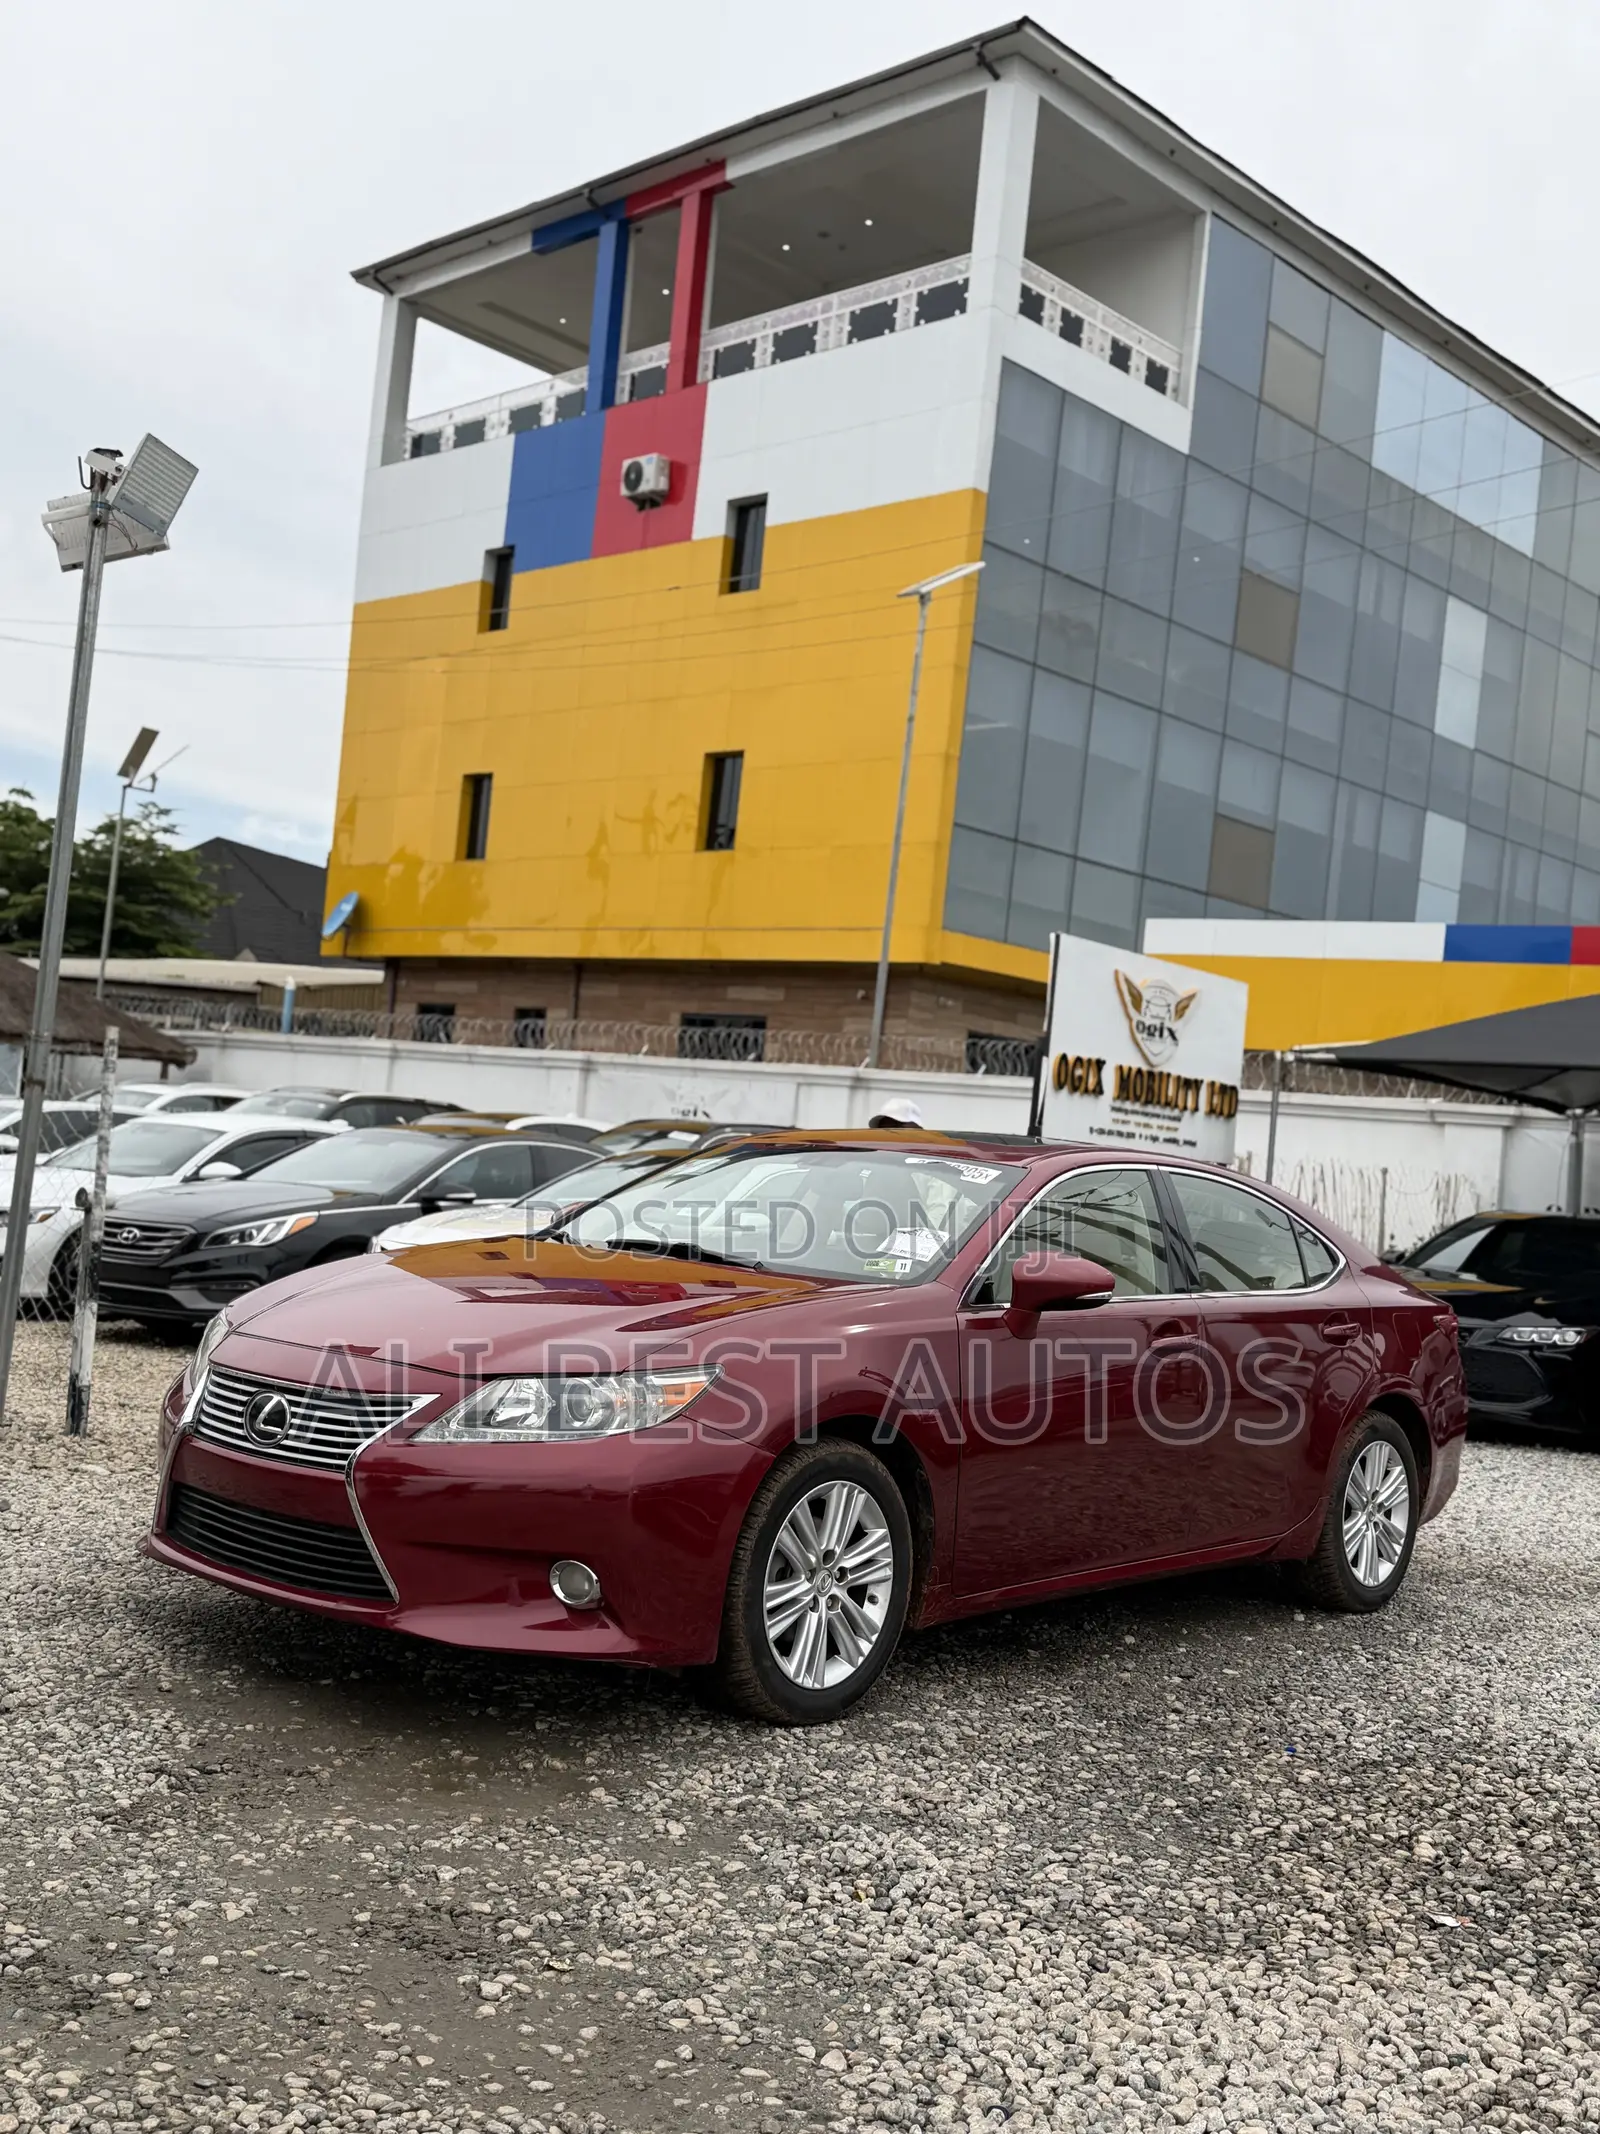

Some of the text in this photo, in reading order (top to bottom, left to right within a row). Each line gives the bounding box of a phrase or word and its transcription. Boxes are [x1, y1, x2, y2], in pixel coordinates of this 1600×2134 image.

[1136, 1019, 1179, 1042] ogix
[1053, 1053, 1239, 1118] OGIX MOBILITY LTD
